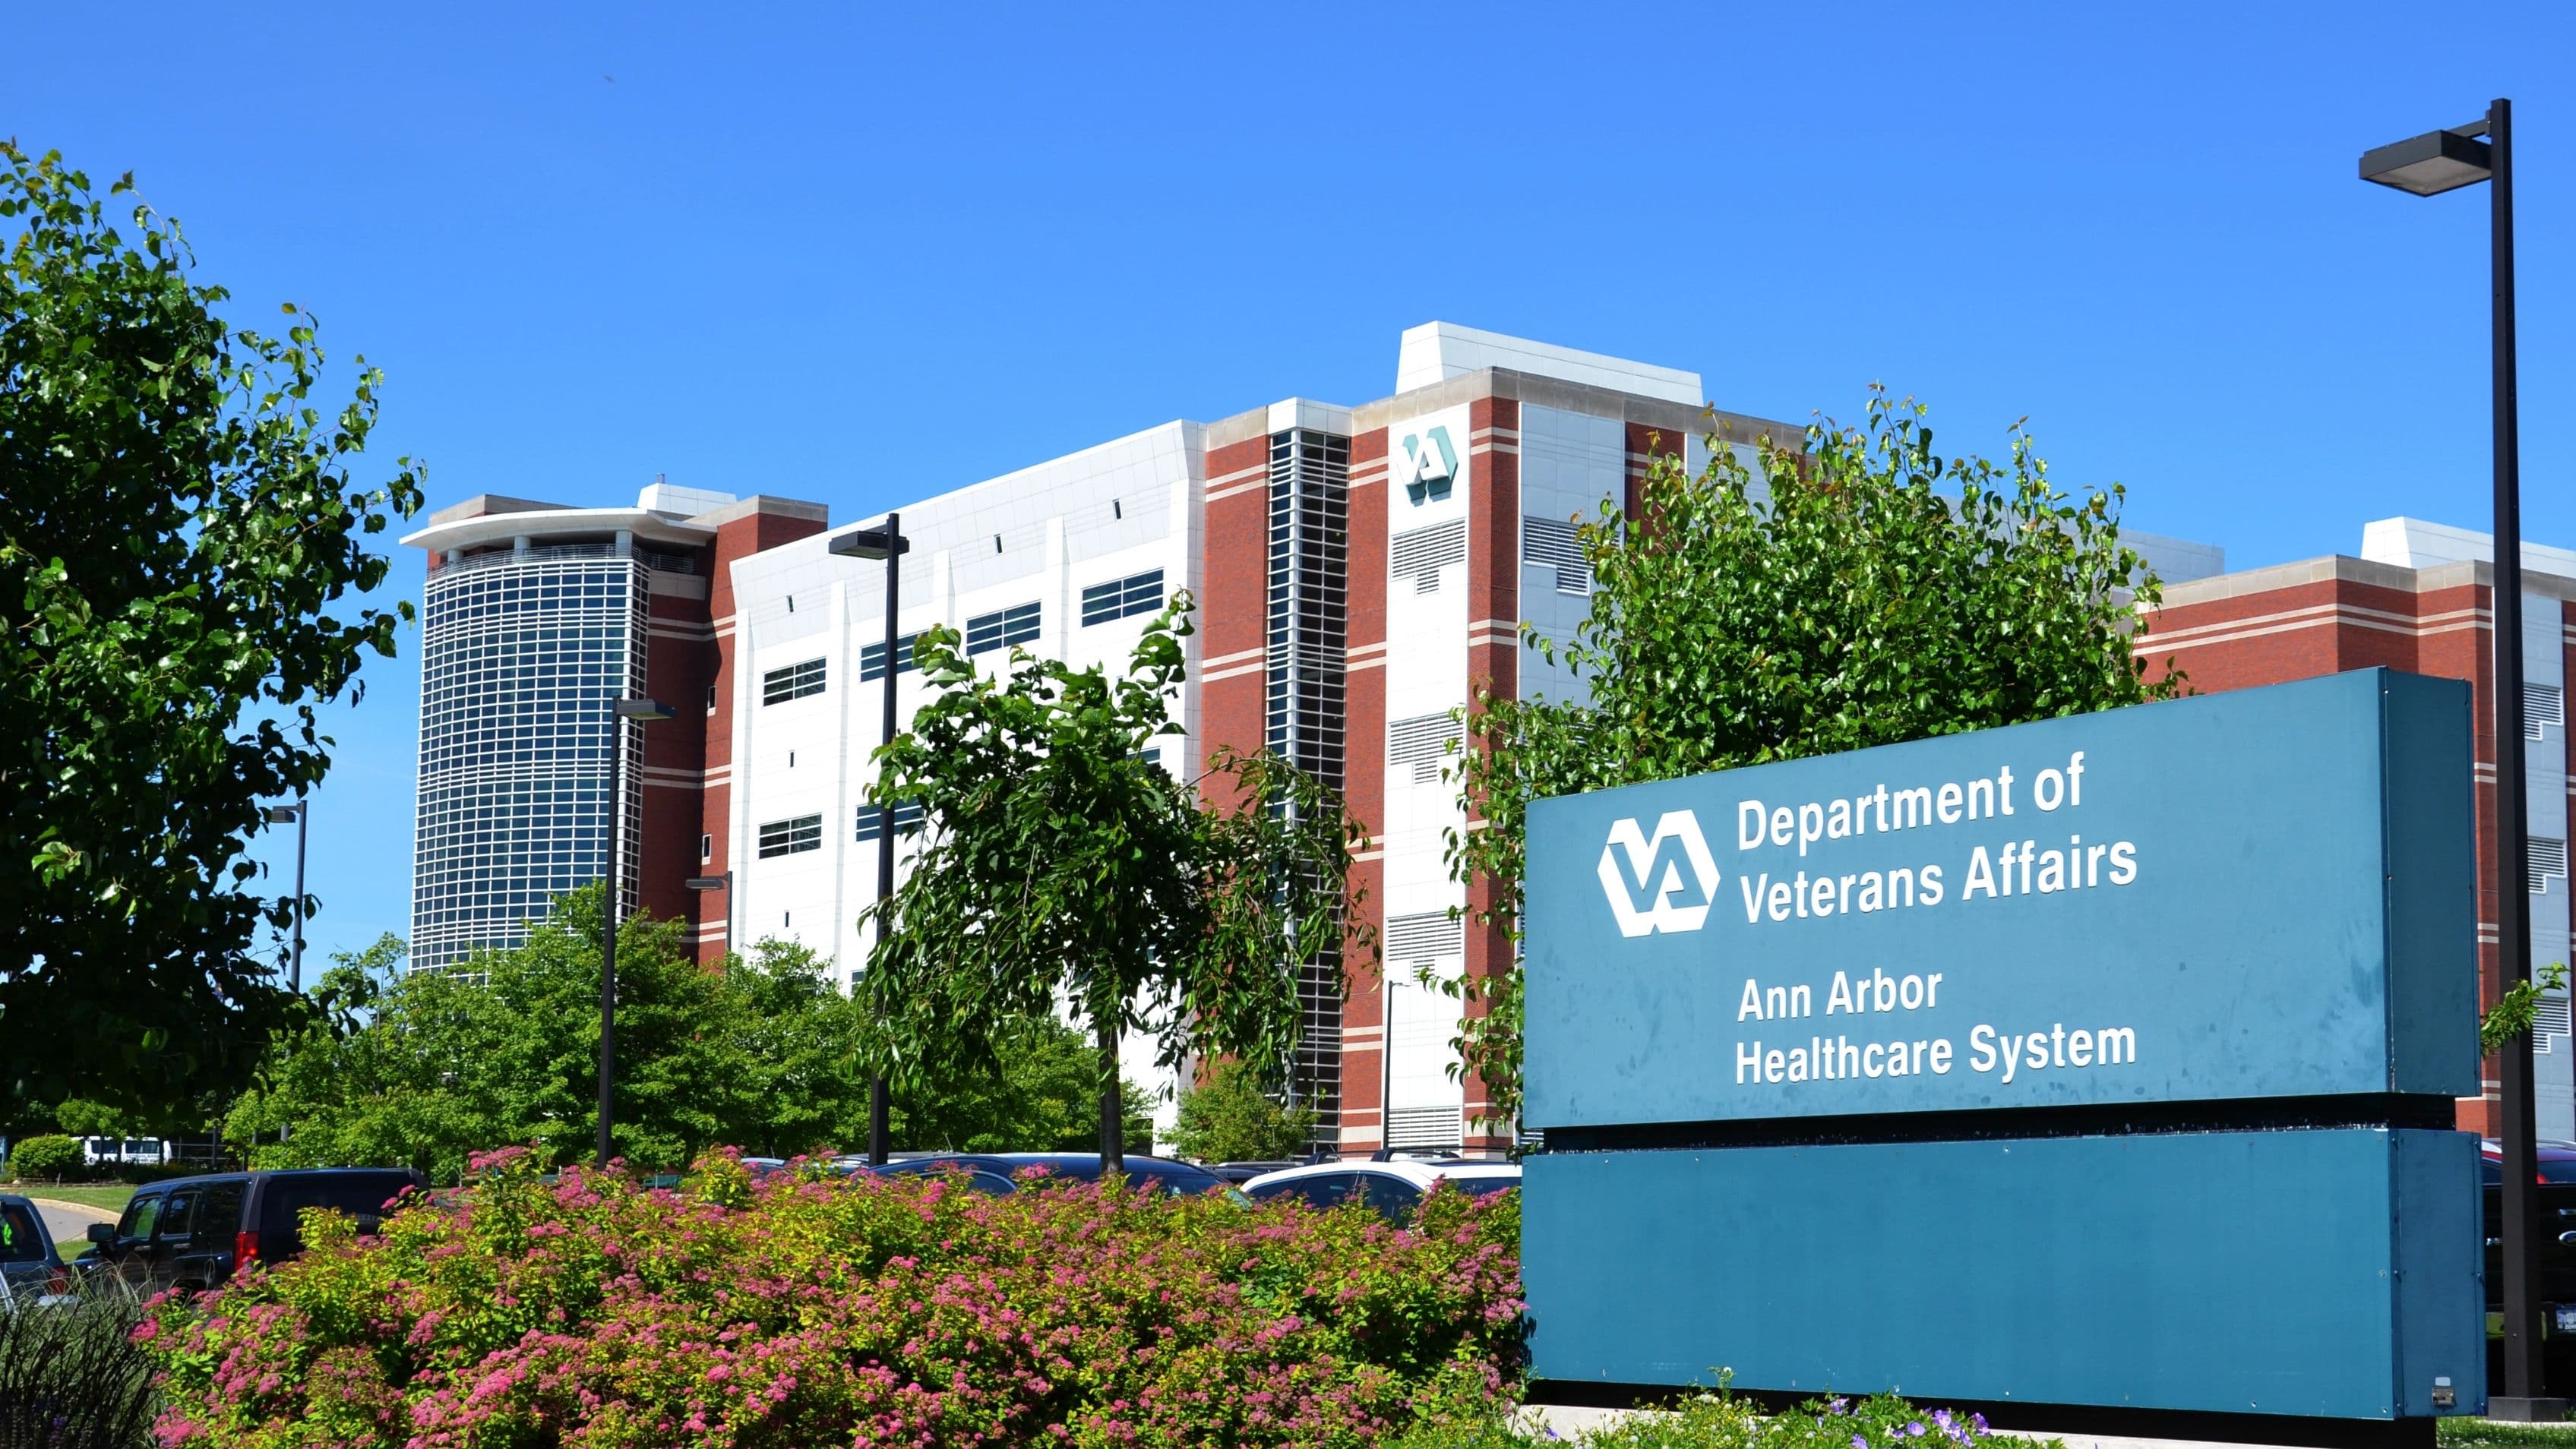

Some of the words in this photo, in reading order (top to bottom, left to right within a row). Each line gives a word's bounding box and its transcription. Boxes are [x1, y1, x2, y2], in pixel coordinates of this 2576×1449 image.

[1397, 425, 1459, 501] VA
[1738, 765, 2015, 857] Department
[2034, 750, 2085, 812] of
[1597, 809, 1721, 938] VA
[1740, 863, 1944, 924] Veterans
[1961, 834, 2138, 901] Affairs
[1737, 978, 1811, 1022] Ann
[1825, 967, 1942, 1015] Arbor
[1736, 1034, 1953, 1084] Healthcare
[1969, 1022, 2136, 1084] System
